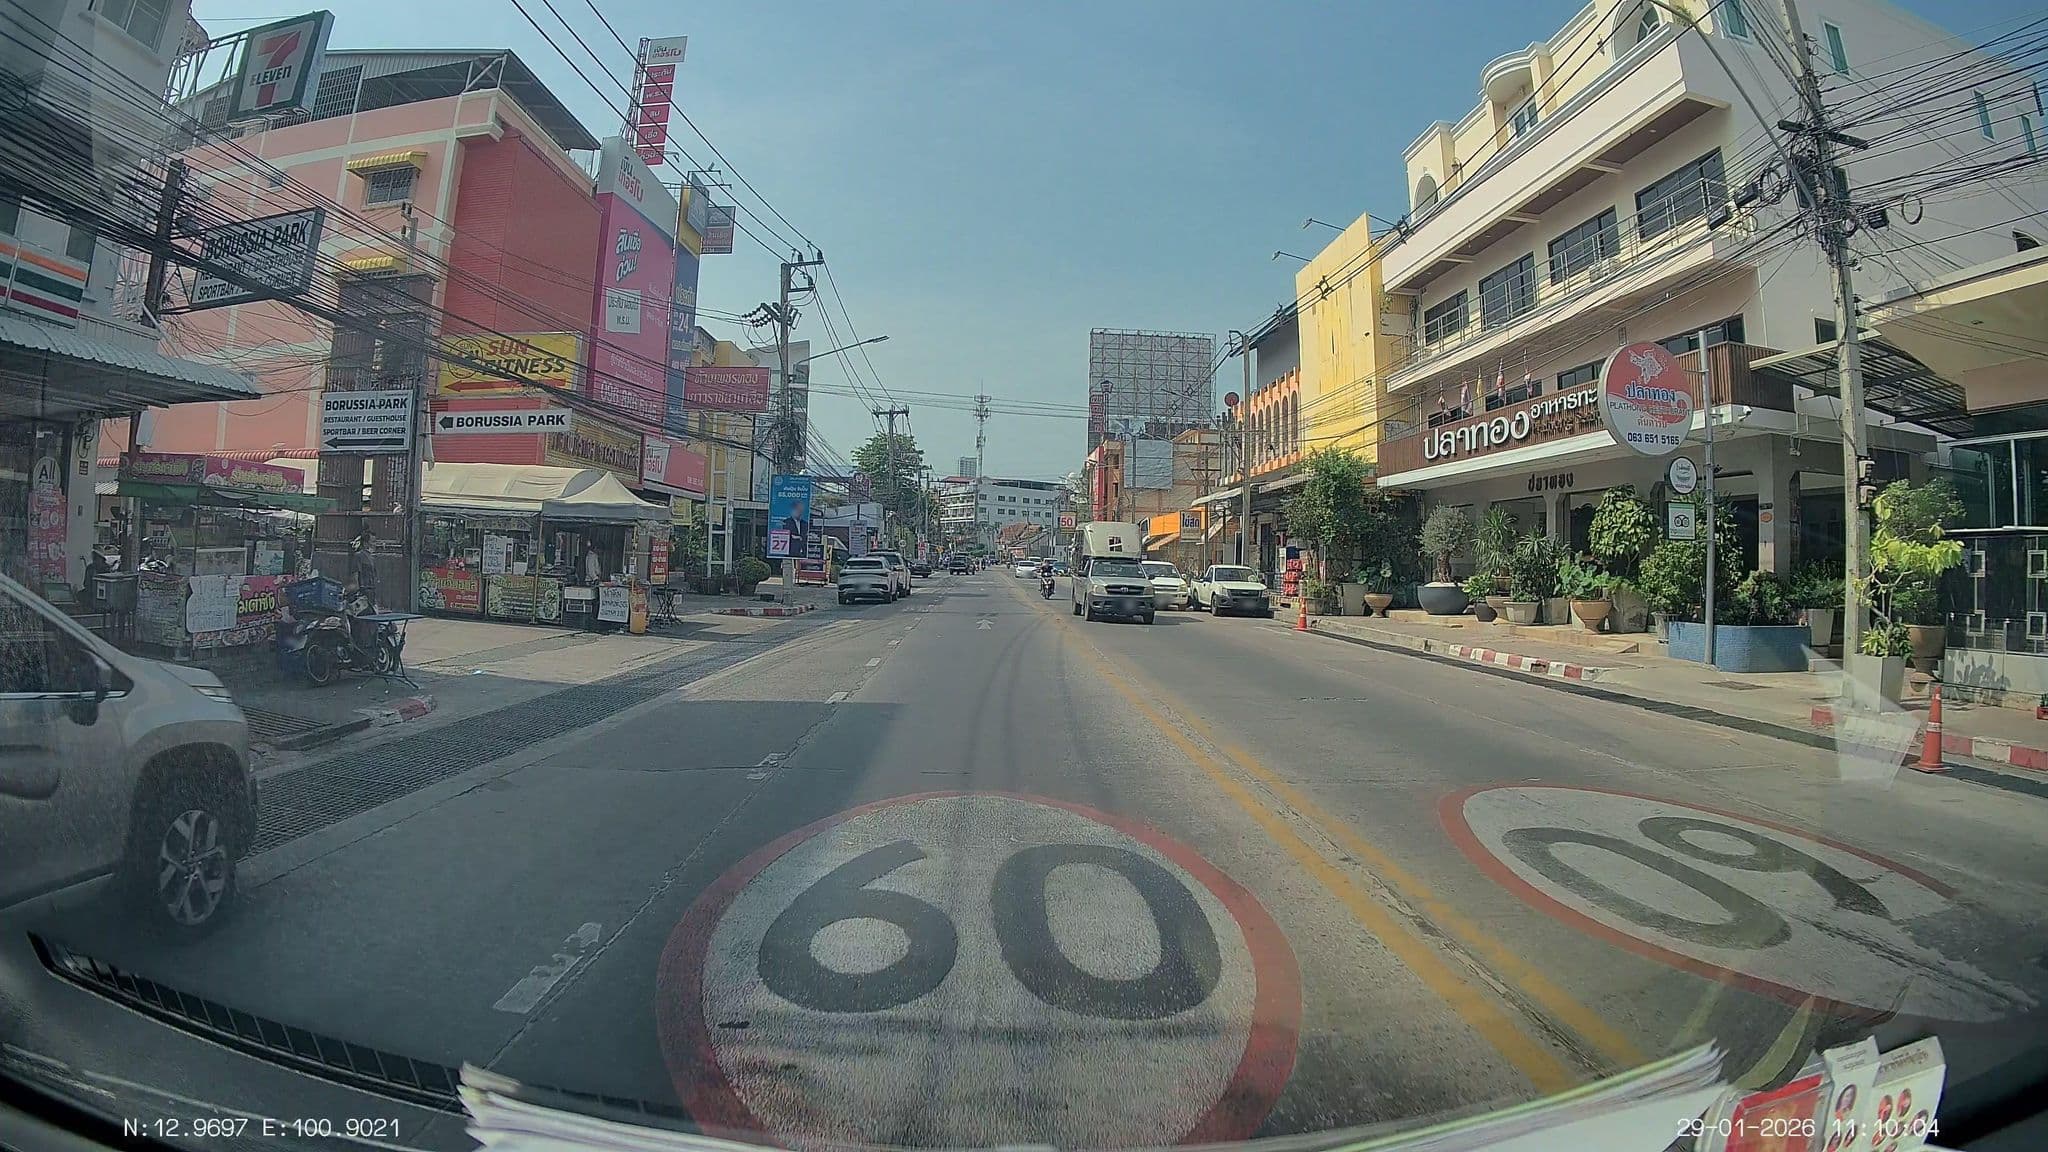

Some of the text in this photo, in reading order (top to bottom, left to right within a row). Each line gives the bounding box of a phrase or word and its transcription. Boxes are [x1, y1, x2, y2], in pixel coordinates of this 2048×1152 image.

[254, 30, 302, 108] 7
[205, 221, 310, 260] BORUSSIA PARK
[486, 339, 530, 357] SUN
[1625, 381, 1677, 403] ปลาทอง
[325, 397, 408, 411] BORUSSIA PARK
[324, 415, 362, 423] RESTAURANT
[456, 414, 566, 428] BORUSSIA PARK
[323, 428, 356, 436] SPORTBAR
[379, 427, 406, 435] CORNER
[1423, 410, 1531, 460] ปลาทอง
[1627, 432, 1642, 443] 063
[1644, 433, 1659, 444] 651
[1061, 516, 1073, 526] 50
[772, 540, 788, 551] 27
[757, 840, 1222, 1020] 60
